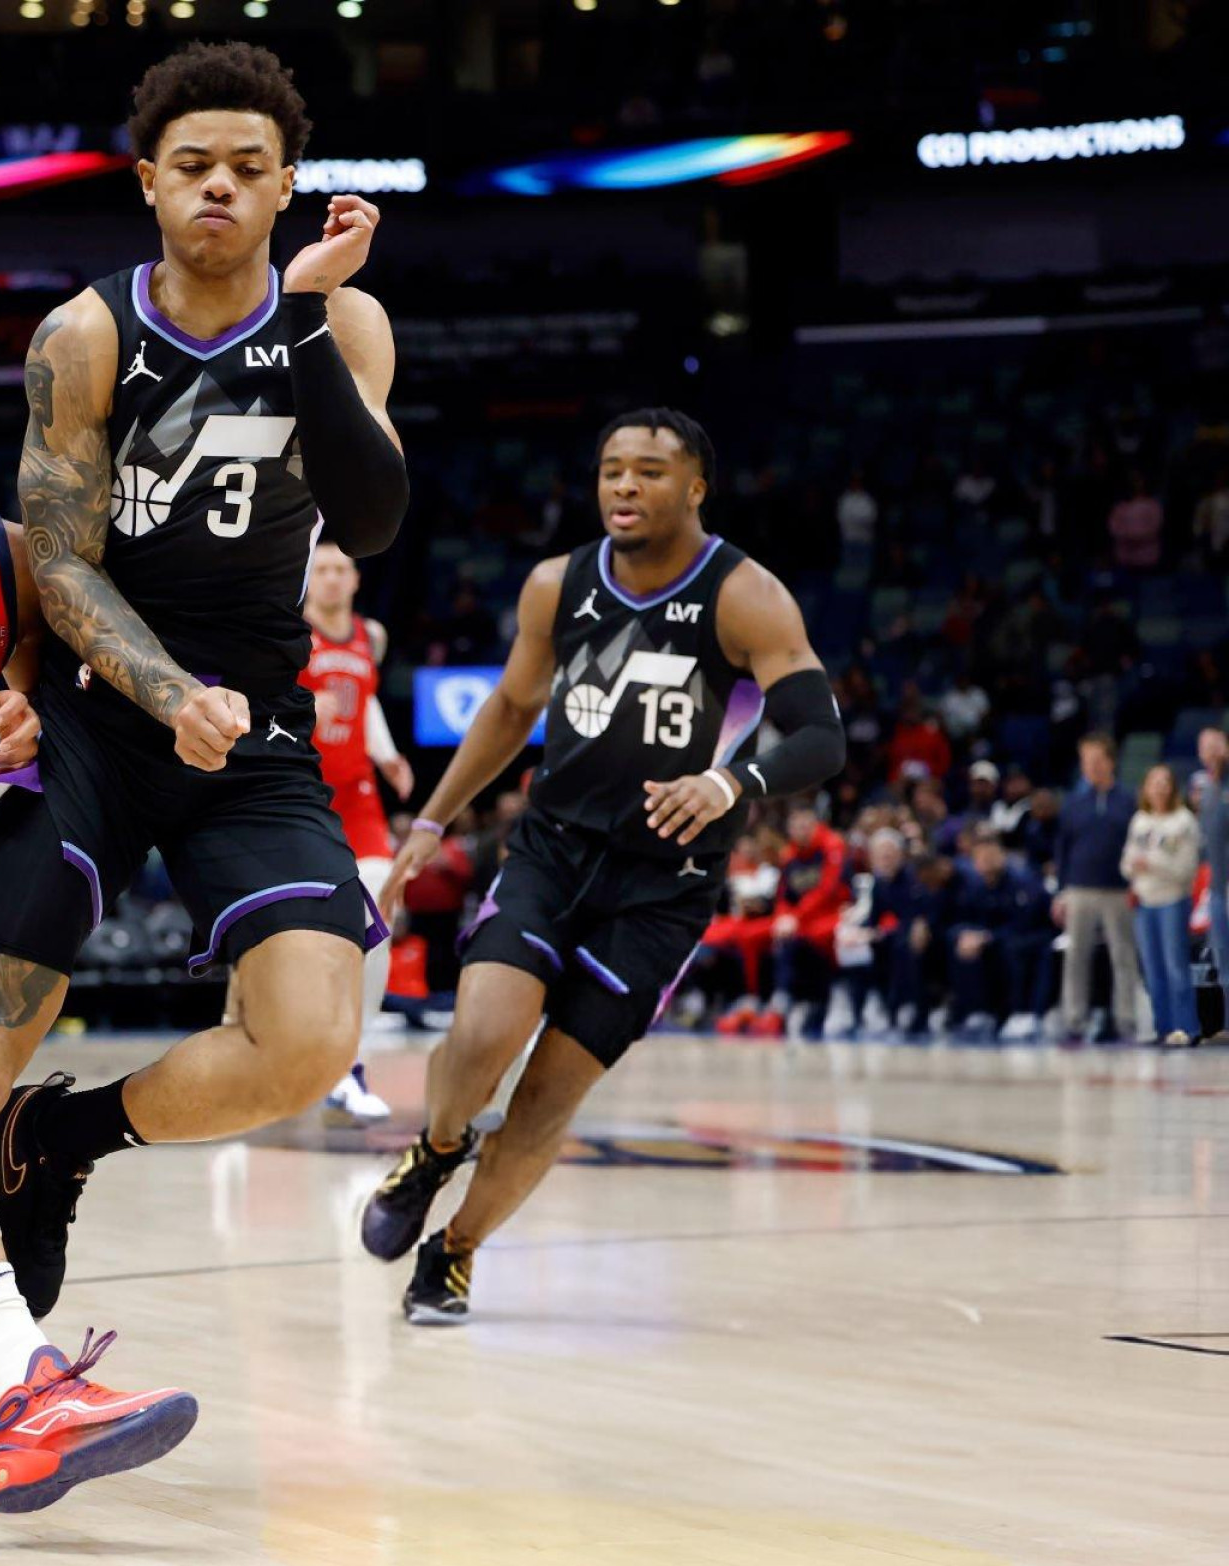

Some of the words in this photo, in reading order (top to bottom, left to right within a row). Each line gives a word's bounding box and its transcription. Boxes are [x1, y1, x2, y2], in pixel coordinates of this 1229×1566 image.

[968, 114, 1185, 165] PRODUCTIONS
[206, 462, 257, 538] 3
[665, 601, 703, 624] LVT
[638, 687, 695, 749] 13
